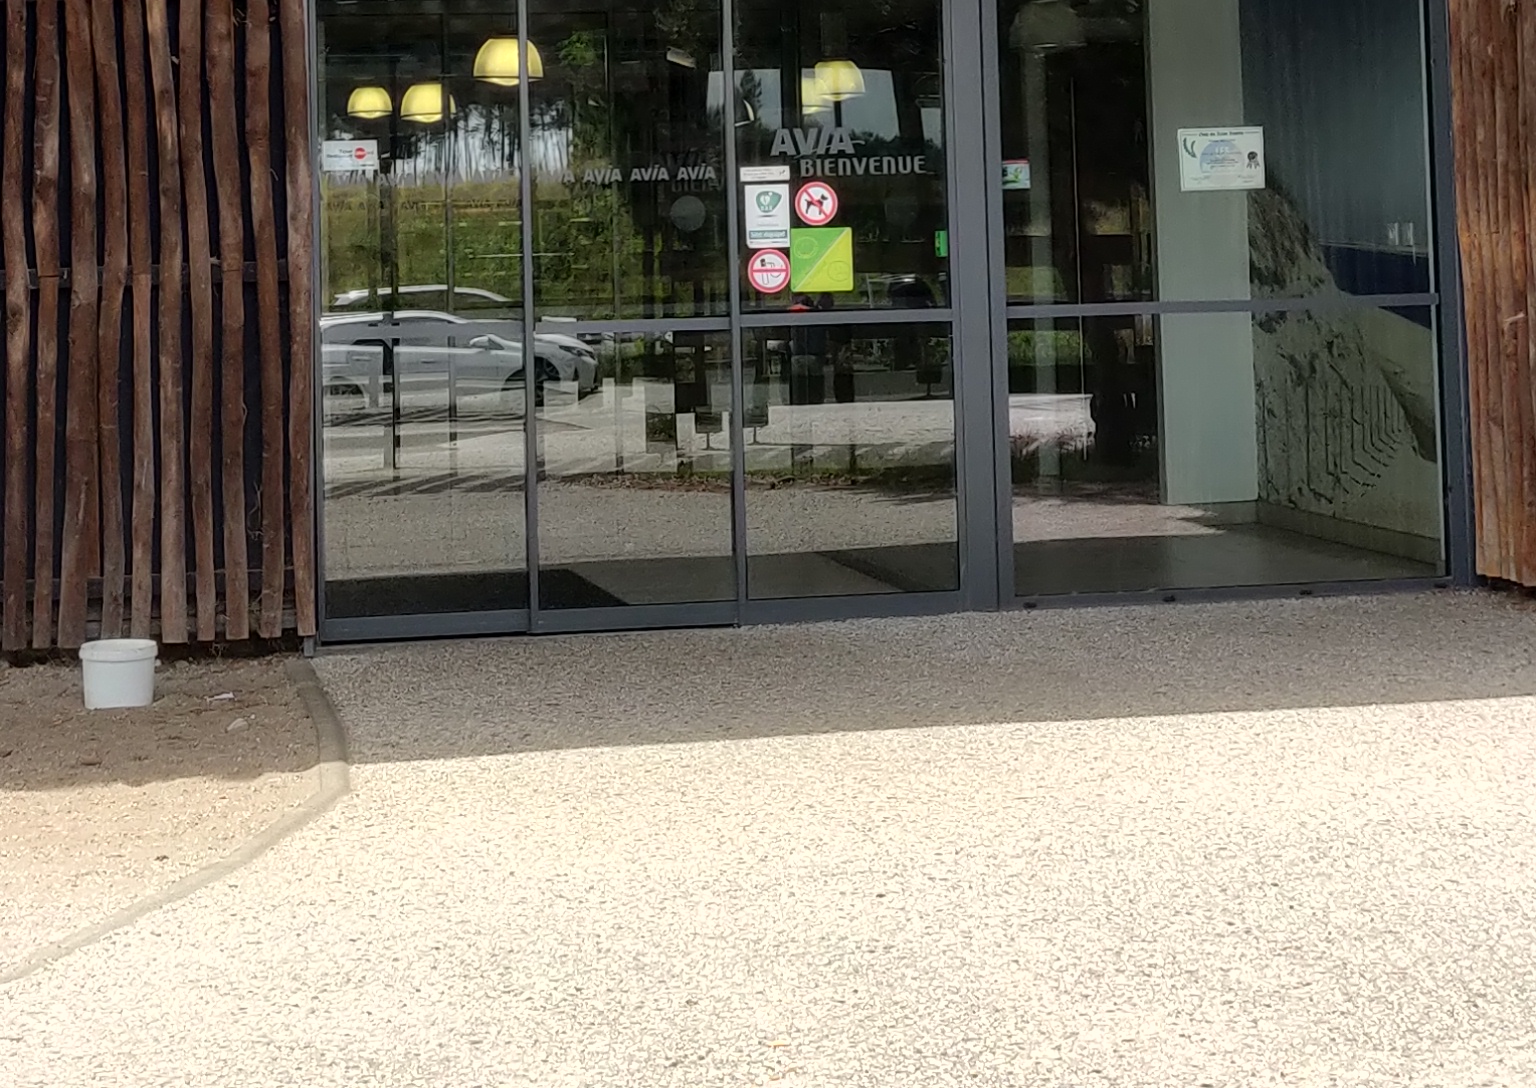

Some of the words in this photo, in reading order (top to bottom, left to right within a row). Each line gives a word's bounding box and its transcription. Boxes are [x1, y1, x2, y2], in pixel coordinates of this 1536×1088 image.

[770, 126, 865, 158] AVIA
[629, 165, 670, 182] AVIA
[676, 163, 716, 181] AVIA
[800, 155, 927, 178] BIENVENUE
